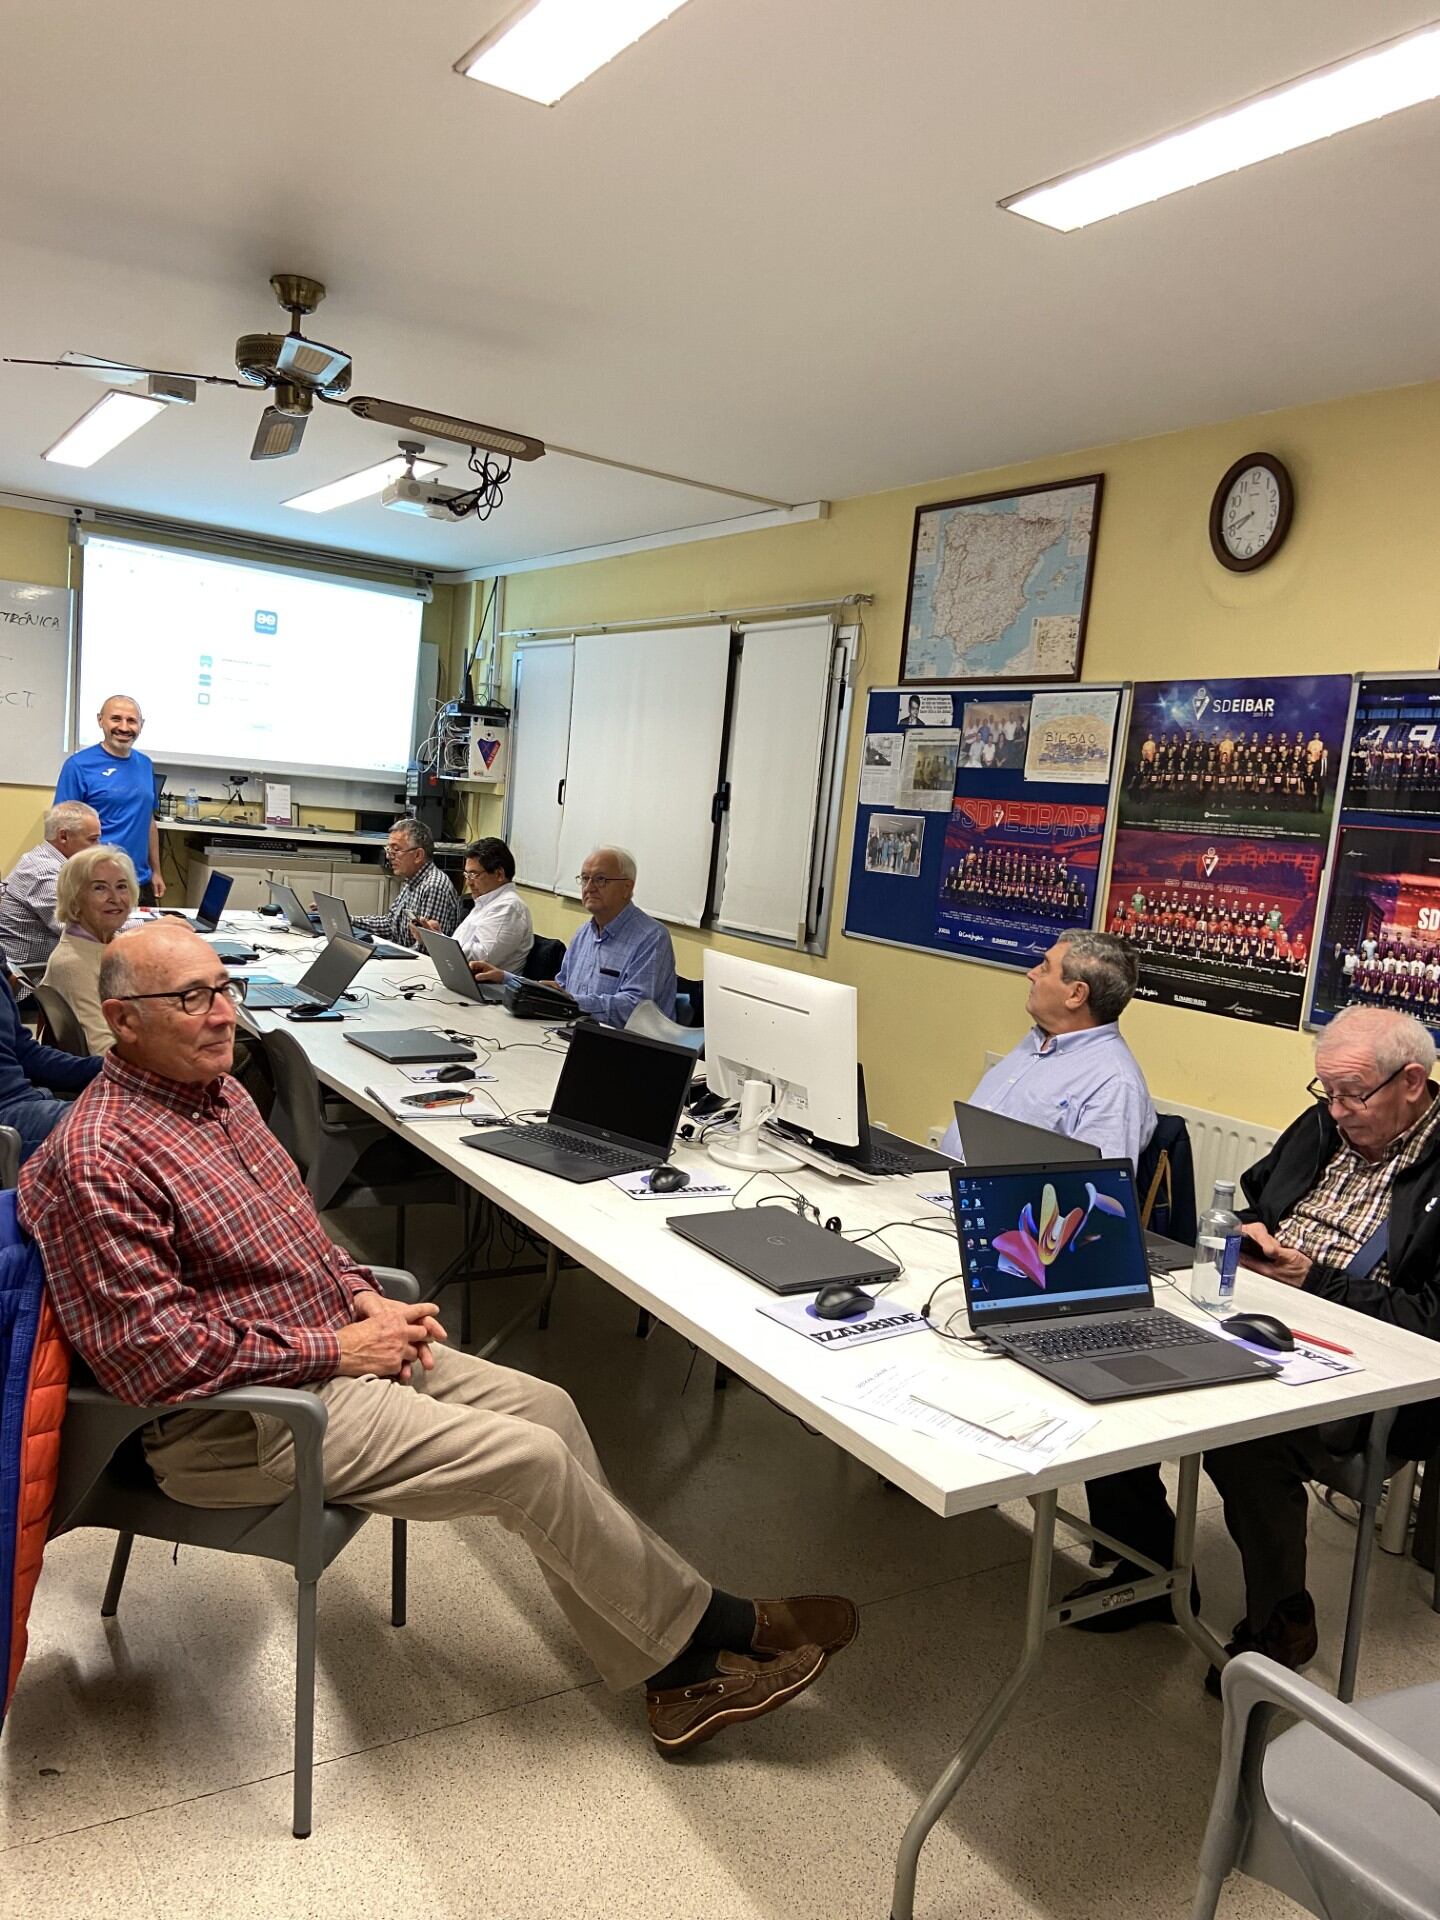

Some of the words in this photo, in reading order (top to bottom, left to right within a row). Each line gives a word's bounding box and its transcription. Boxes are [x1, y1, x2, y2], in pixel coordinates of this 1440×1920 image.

[1252, 472, 1261, 484] 12
[1240, 481, 1247, 493] 11
[1231, 495, 1242, 507] 10
[1229, 510, 1236, 522] 9
[1236, 537, 1242, 549] 7
[1257, 534, 1265, 547] 5
[1245, 543, 1252, 555] 6
[0, 611, 60, 629] TRÓNICA
[961, 800, 992, 829] SD
[1003, 803, 1089, 837] EIBAR
[1417, 907, 1440, 931] SD
